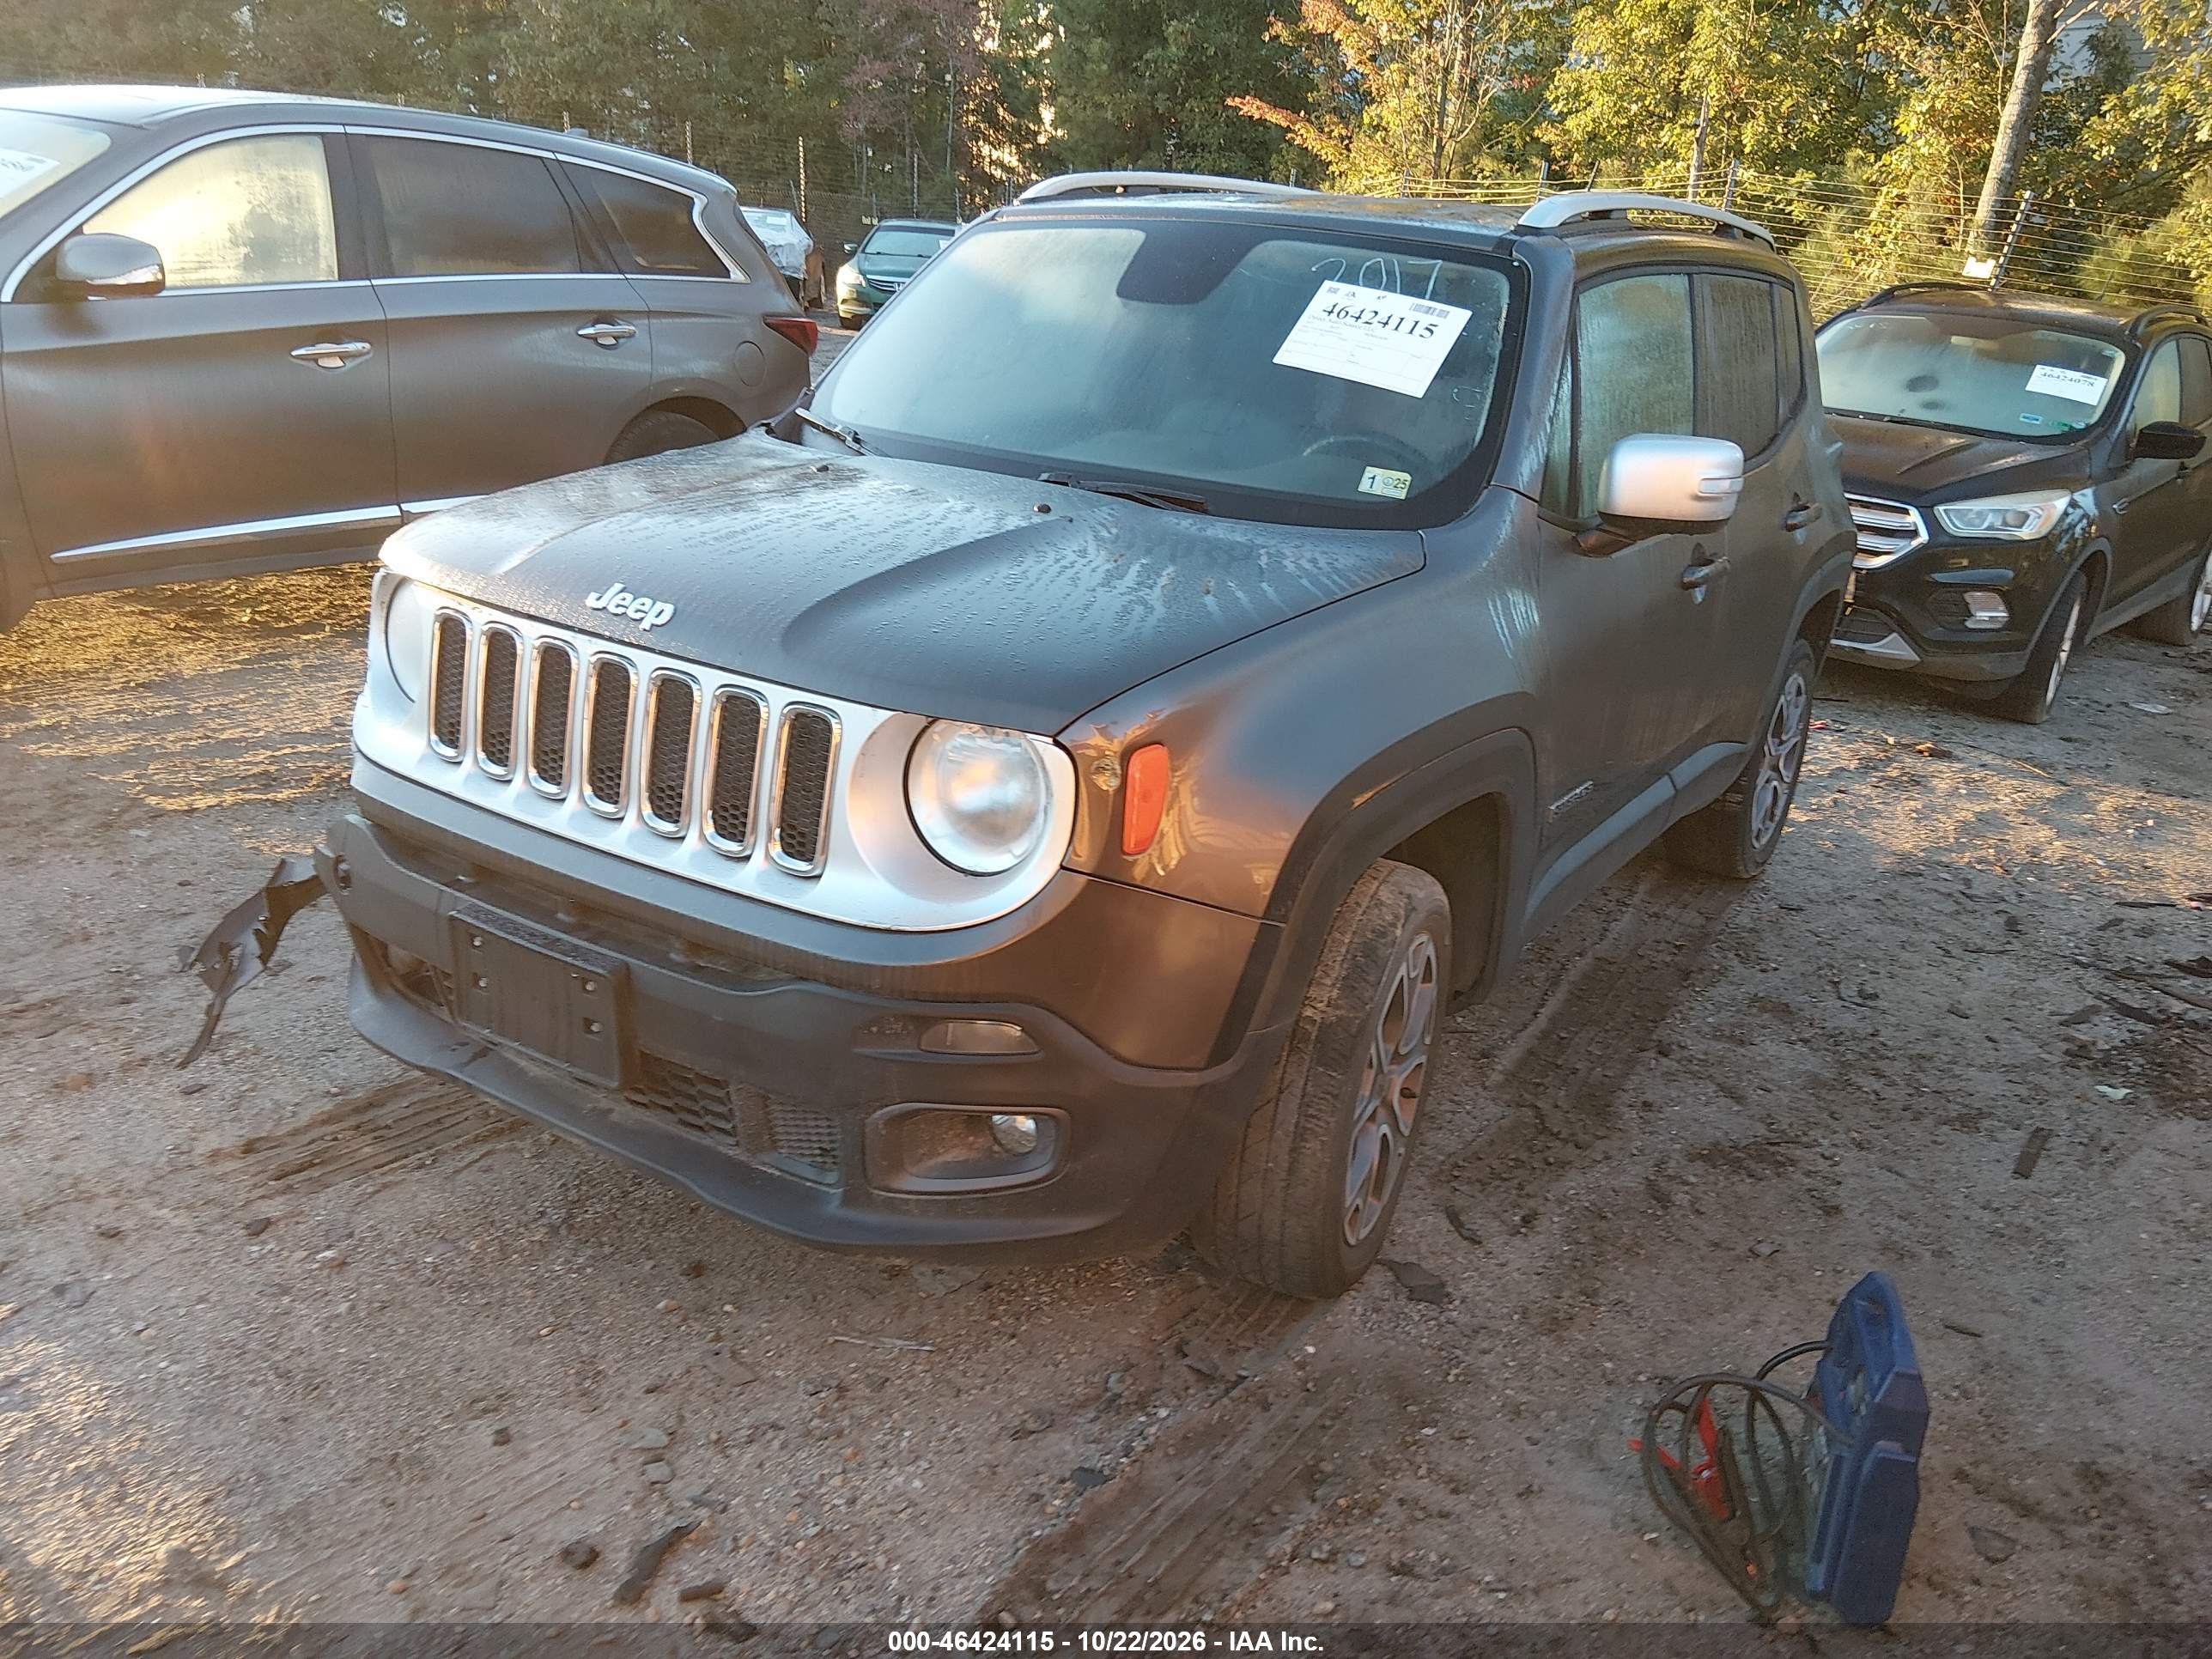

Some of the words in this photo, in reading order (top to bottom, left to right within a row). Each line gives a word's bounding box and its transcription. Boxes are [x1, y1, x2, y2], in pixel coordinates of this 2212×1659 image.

[1322, 301, 1440, 339] 46424115
[2039, 371, 2096, 387] 46424078
[1367, 474, 1377, 489] 1
[1393, 477, 1409, 490] 25
[585, 581, 676, 632] Jeep
